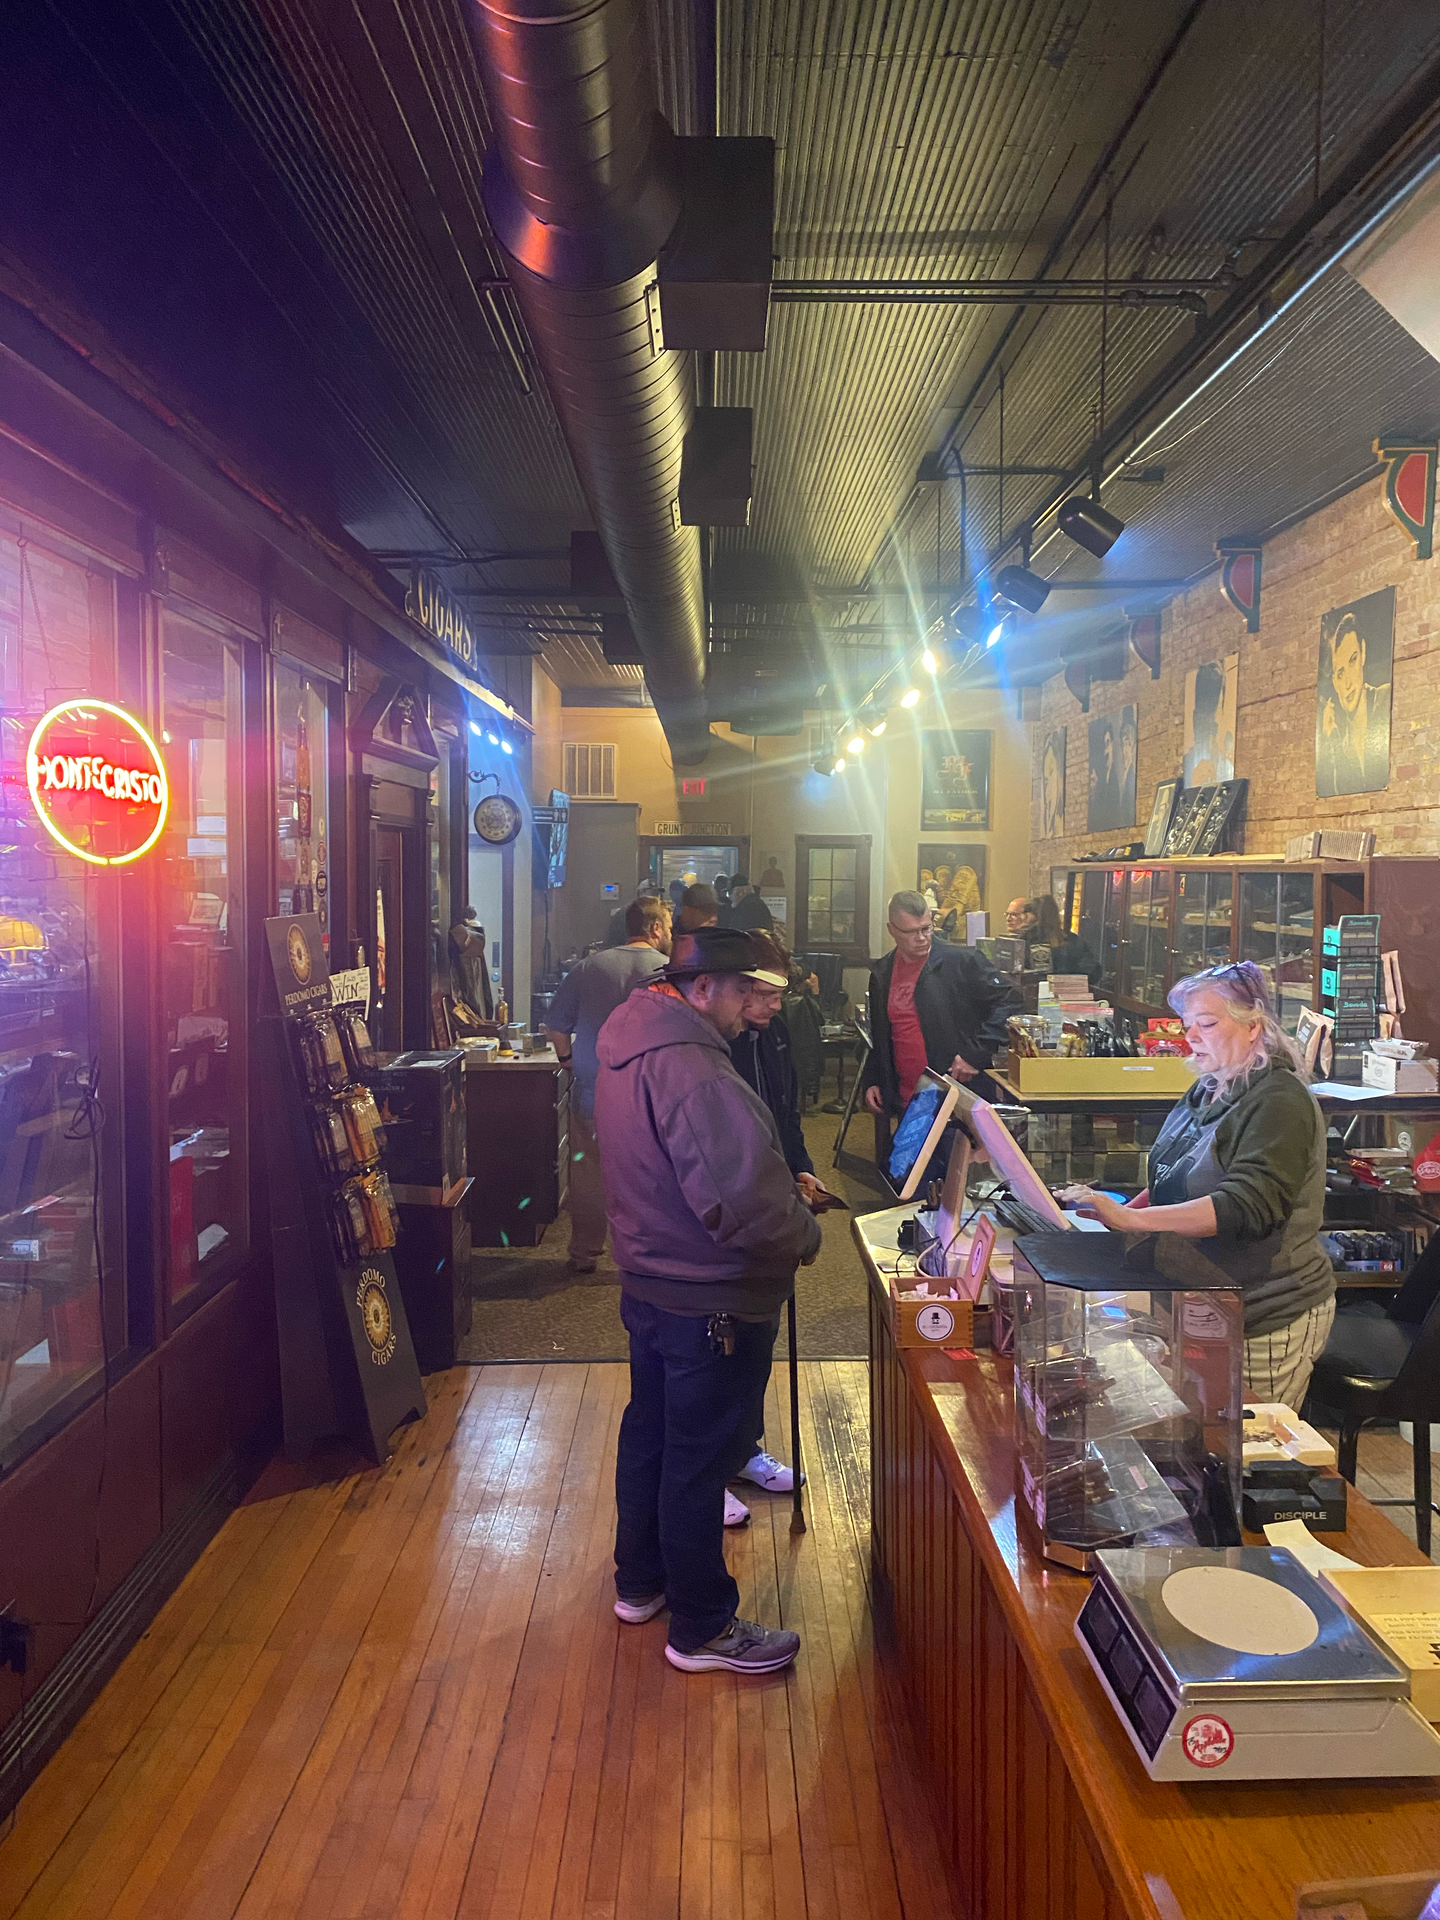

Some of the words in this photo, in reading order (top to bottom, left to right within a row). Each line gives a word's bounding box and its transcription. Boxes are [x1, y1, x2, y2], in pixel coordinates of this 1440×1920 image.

[417, 569, 472, 661] CIGARS
[683, 778, 707, 795] EXIT
[657, 823, 685, 835] GRUNT
[690, 823, 730, 836] JUNCTION
[285, 989, 310, 1005] PERDOMO
[310, 983, 327, 998] CIGARS
[331, 975, 358, 1002] WIN
[357, 1268, 385, 1307] PERDOMO
[371, 1333, 396, 1365] CIGARS
[1274, 1511, 1327, 1520] DISCIPLE
